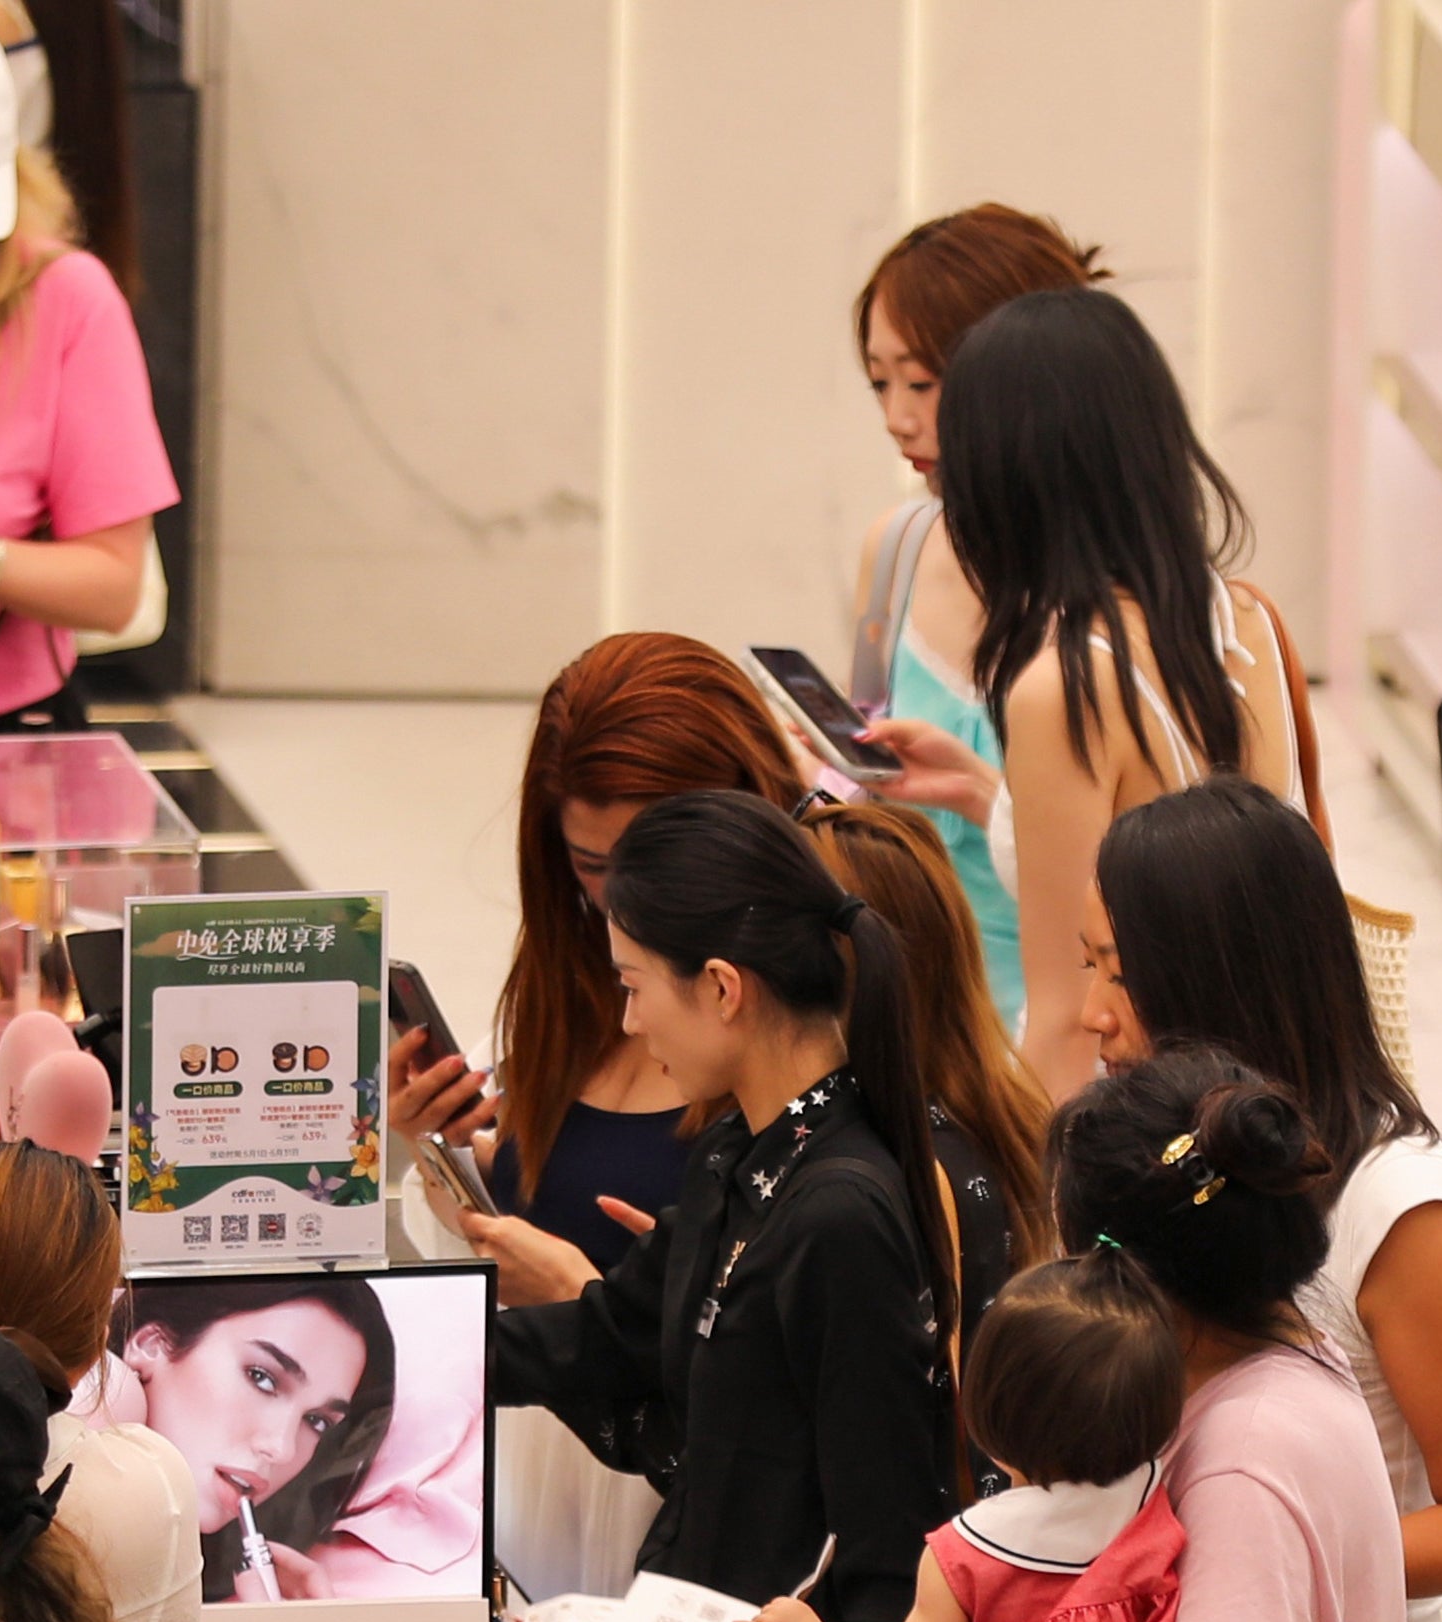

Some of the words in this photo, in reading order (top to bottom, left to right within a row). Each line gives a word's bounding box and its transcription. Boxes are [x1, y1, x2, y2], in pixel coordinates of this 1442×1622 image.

[176, 925, 336, 956] 中免全球悦享季
[182, 1084, 234, 1095] 一口价商品
[272, 1081, 324, 1092] 一口价商品
